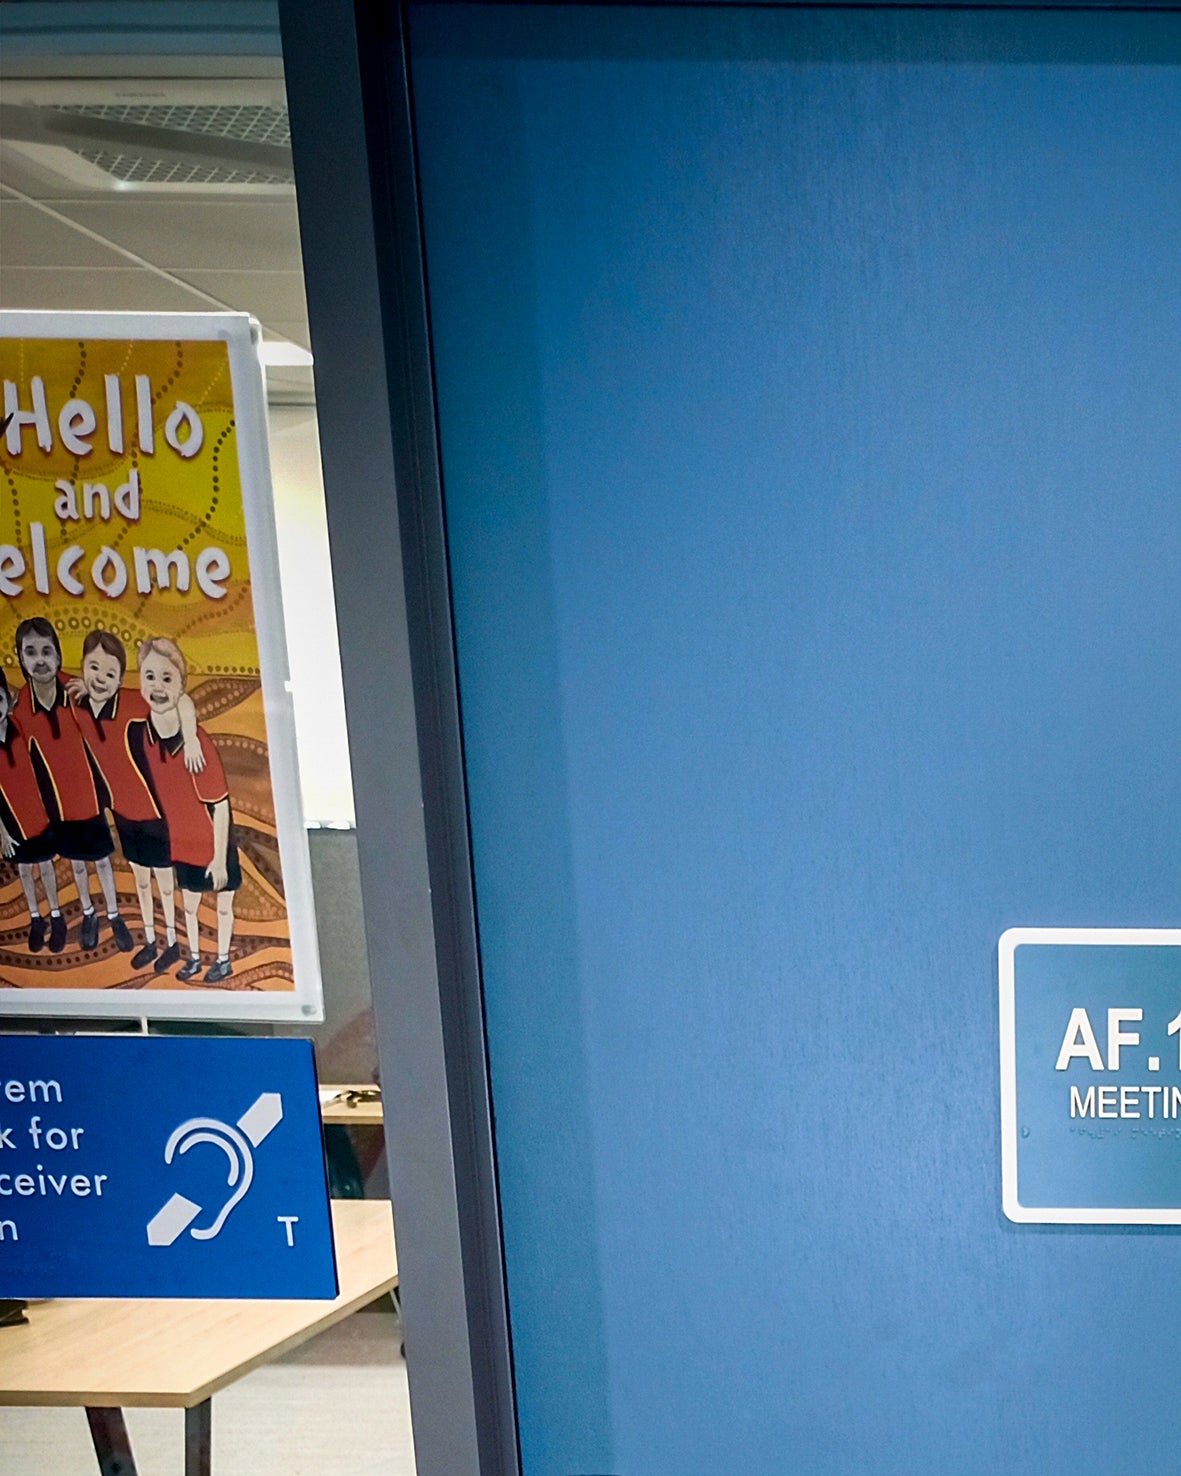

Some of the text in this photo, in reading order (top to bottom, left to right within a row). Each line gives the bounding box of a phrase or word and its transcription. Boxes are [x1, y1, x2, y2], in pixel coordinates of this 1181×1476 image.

[3, 373, 204, 457] Hello
[54, 468, 141, 521] and
[0, 1080, 63, 1103] em
[28, 1115, 85, 1150] for
[0, 1164, 108, 1197] ceiver
[277, 1216, 299, 1247] T
